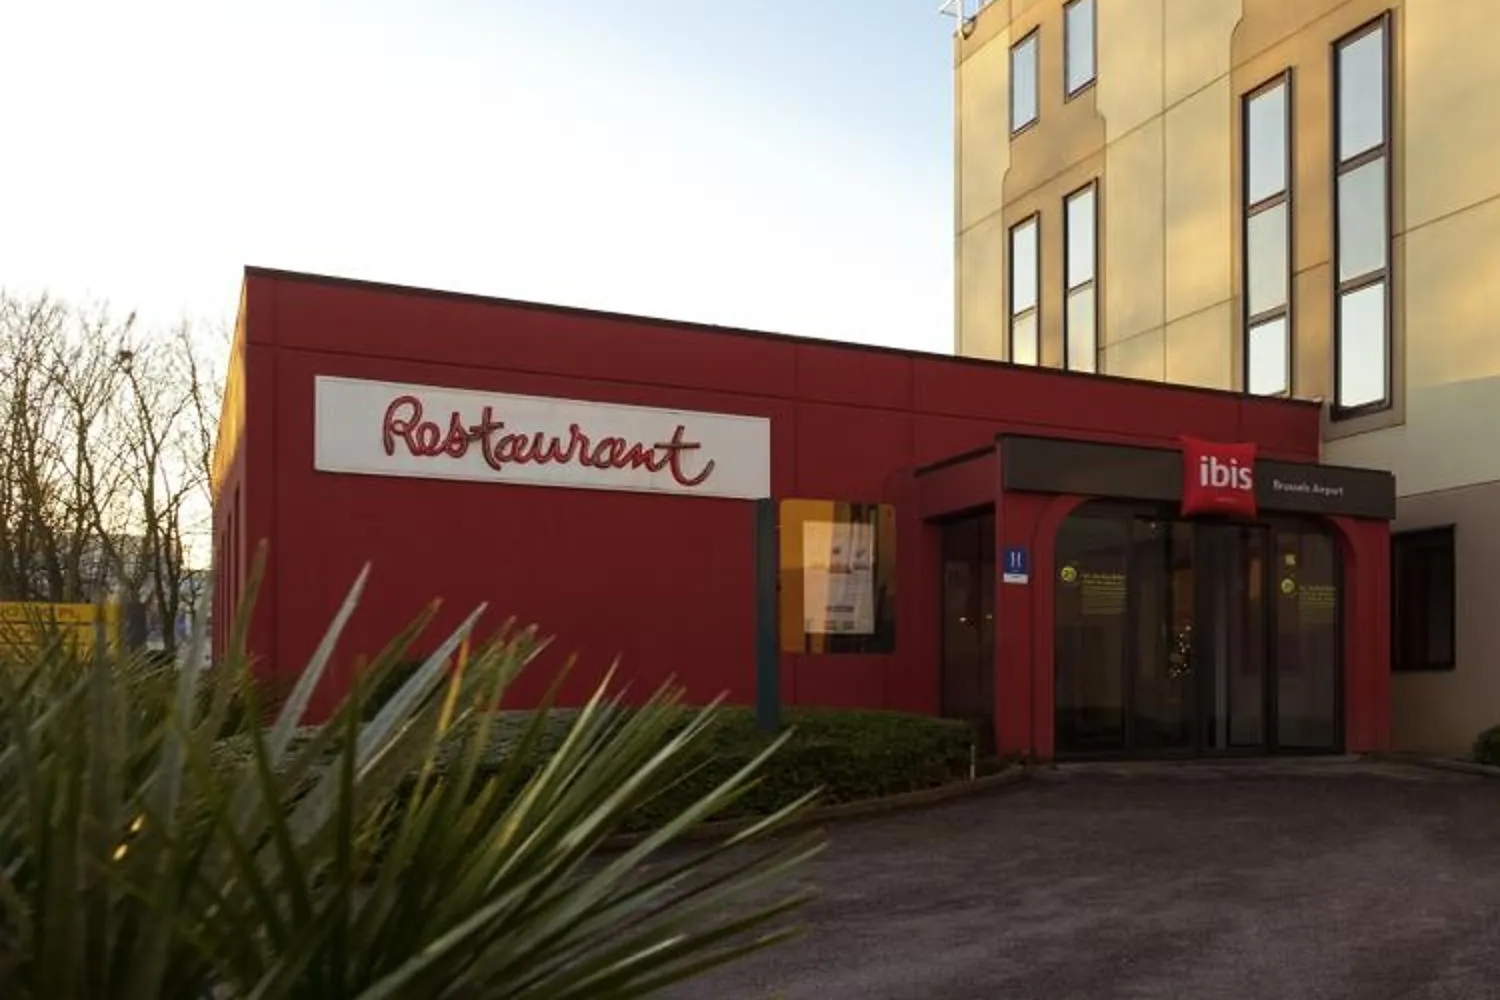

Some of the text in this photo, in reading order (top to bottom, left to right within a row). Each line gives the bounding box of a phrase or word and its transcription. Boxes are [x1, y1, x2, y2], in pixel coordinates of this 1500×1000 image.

[383, 395, 715, 487] Restaurant
[1200, 455, 1253, 490] ibis
[1272, 478, 1344, 497] Brussels Airport
